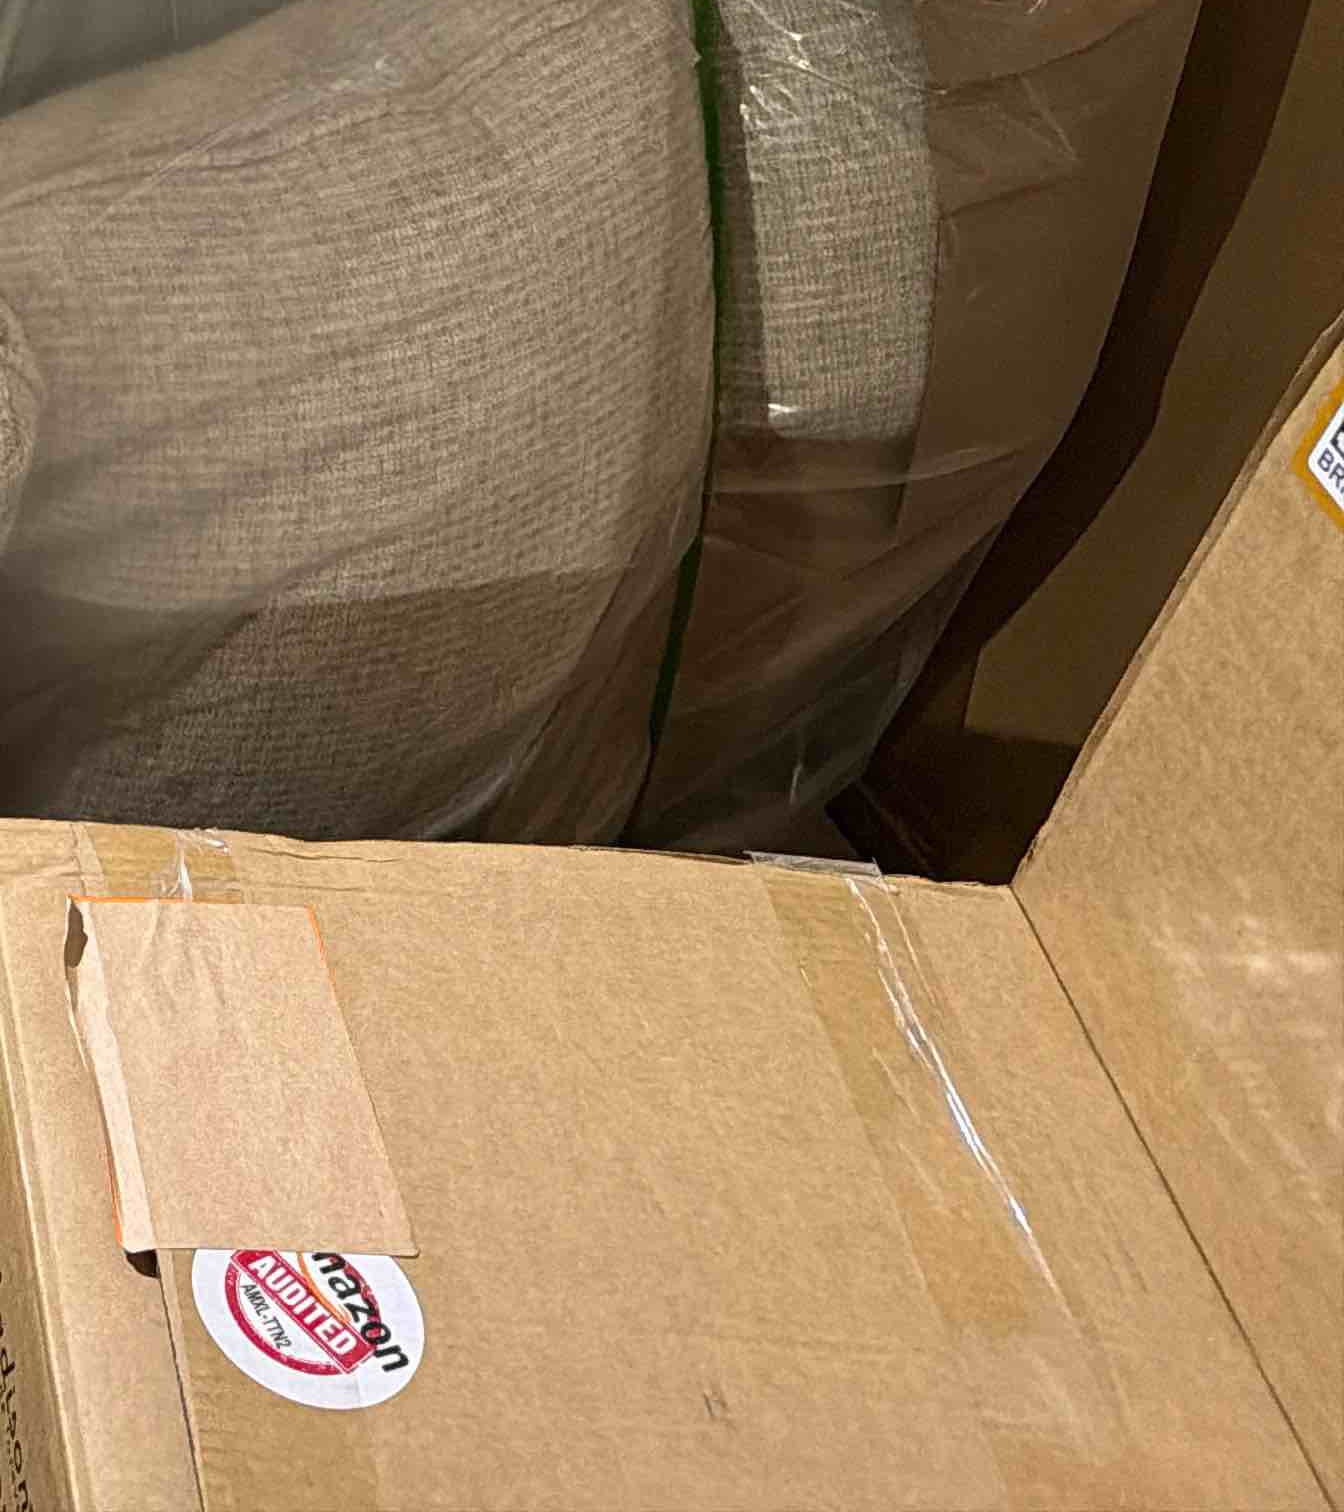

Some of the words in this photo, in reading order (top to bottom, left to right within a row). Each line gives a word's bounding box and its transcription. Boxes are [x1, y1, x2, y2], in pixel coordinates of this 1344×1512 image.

[1317, 448, 1344, 494] BR
[243, 1284, 293, 1349] AMXL-TTN2
[247, 1254, 358, 1356] AUDITED
